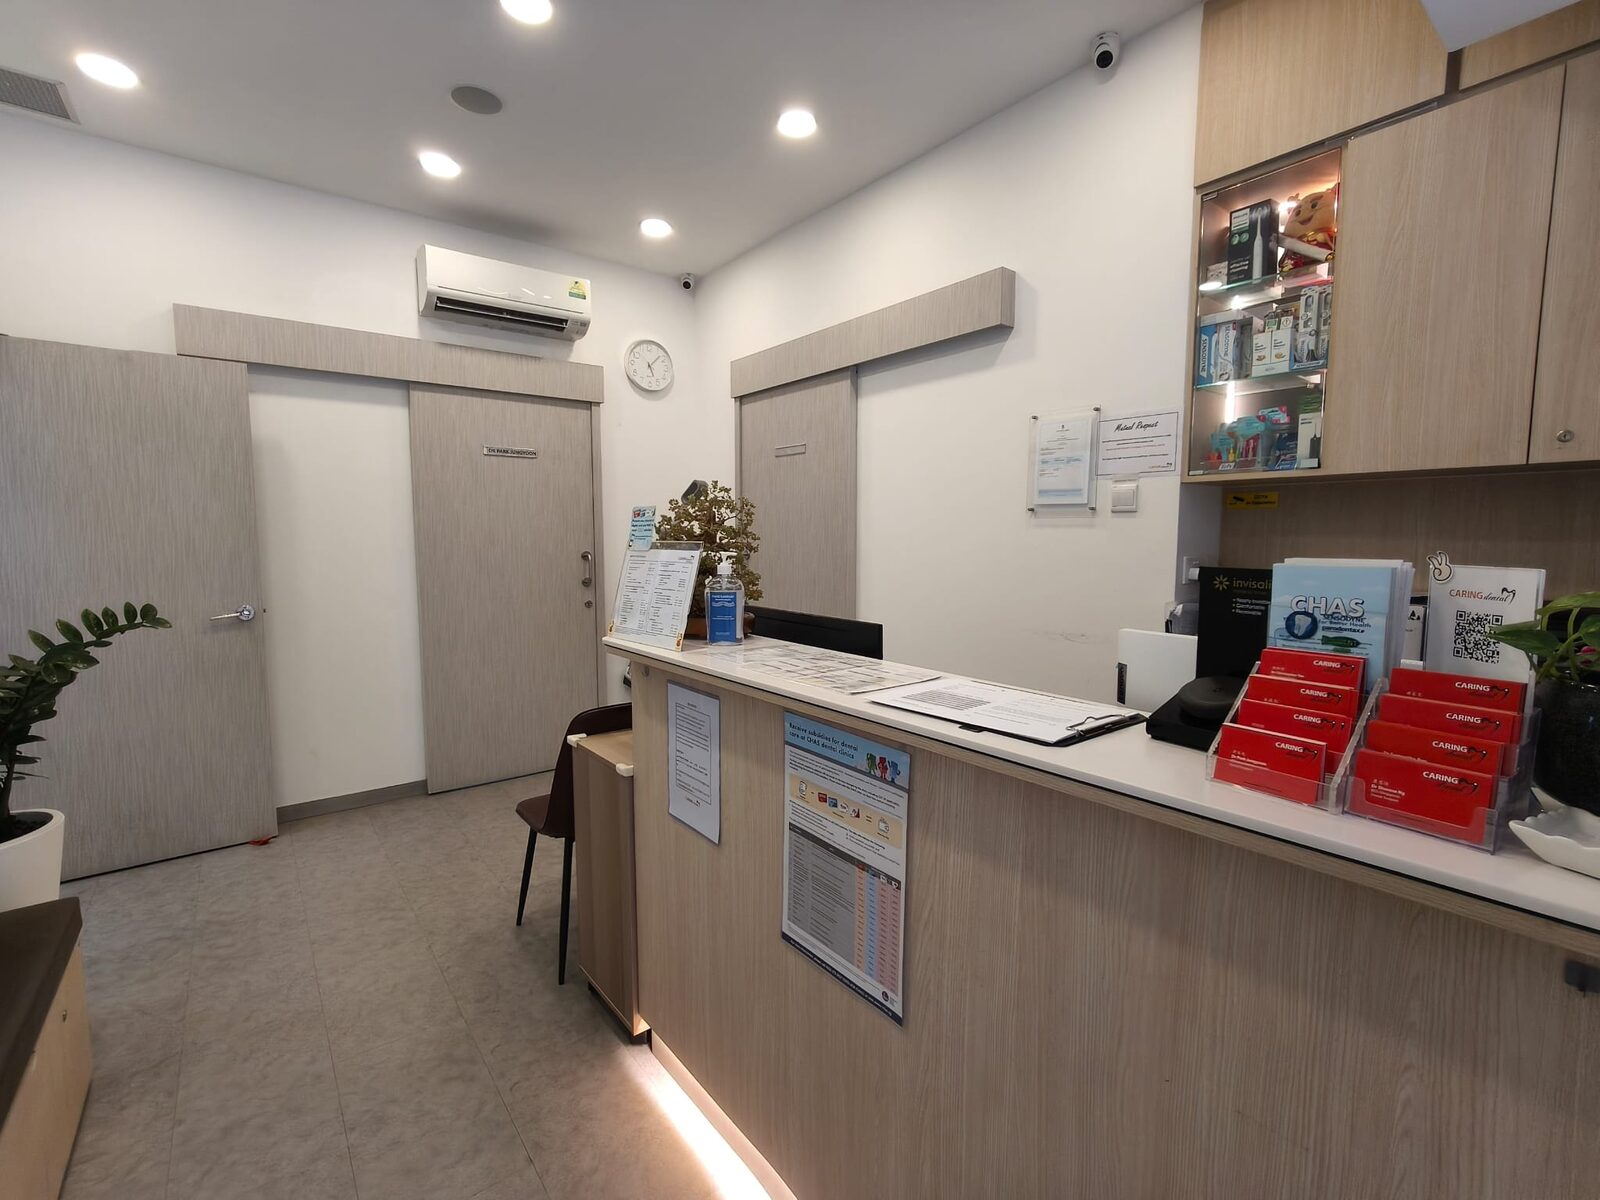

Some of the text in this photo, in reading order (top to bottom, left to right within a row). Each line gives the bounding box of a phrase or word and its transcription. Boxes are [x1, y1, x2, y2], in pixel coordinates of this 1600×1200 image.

[1200, 338, 1208, 373] SENSODYNE
[1449, 588, 1484, 601] CARING
[1291, 595, 1365, 618] CHAS
[1455, 681, 1490, 692] CARING
[1300, 688, 1328, 698] CARING
[1293, 713, 1321, 724] CARING
[1446, 712, 1481, 724] CARING
[1275, 741, 1303, 753] CARING
[1432, 740, 1468, 753] CARING
[1422, 771, 1459, 784] CARING
